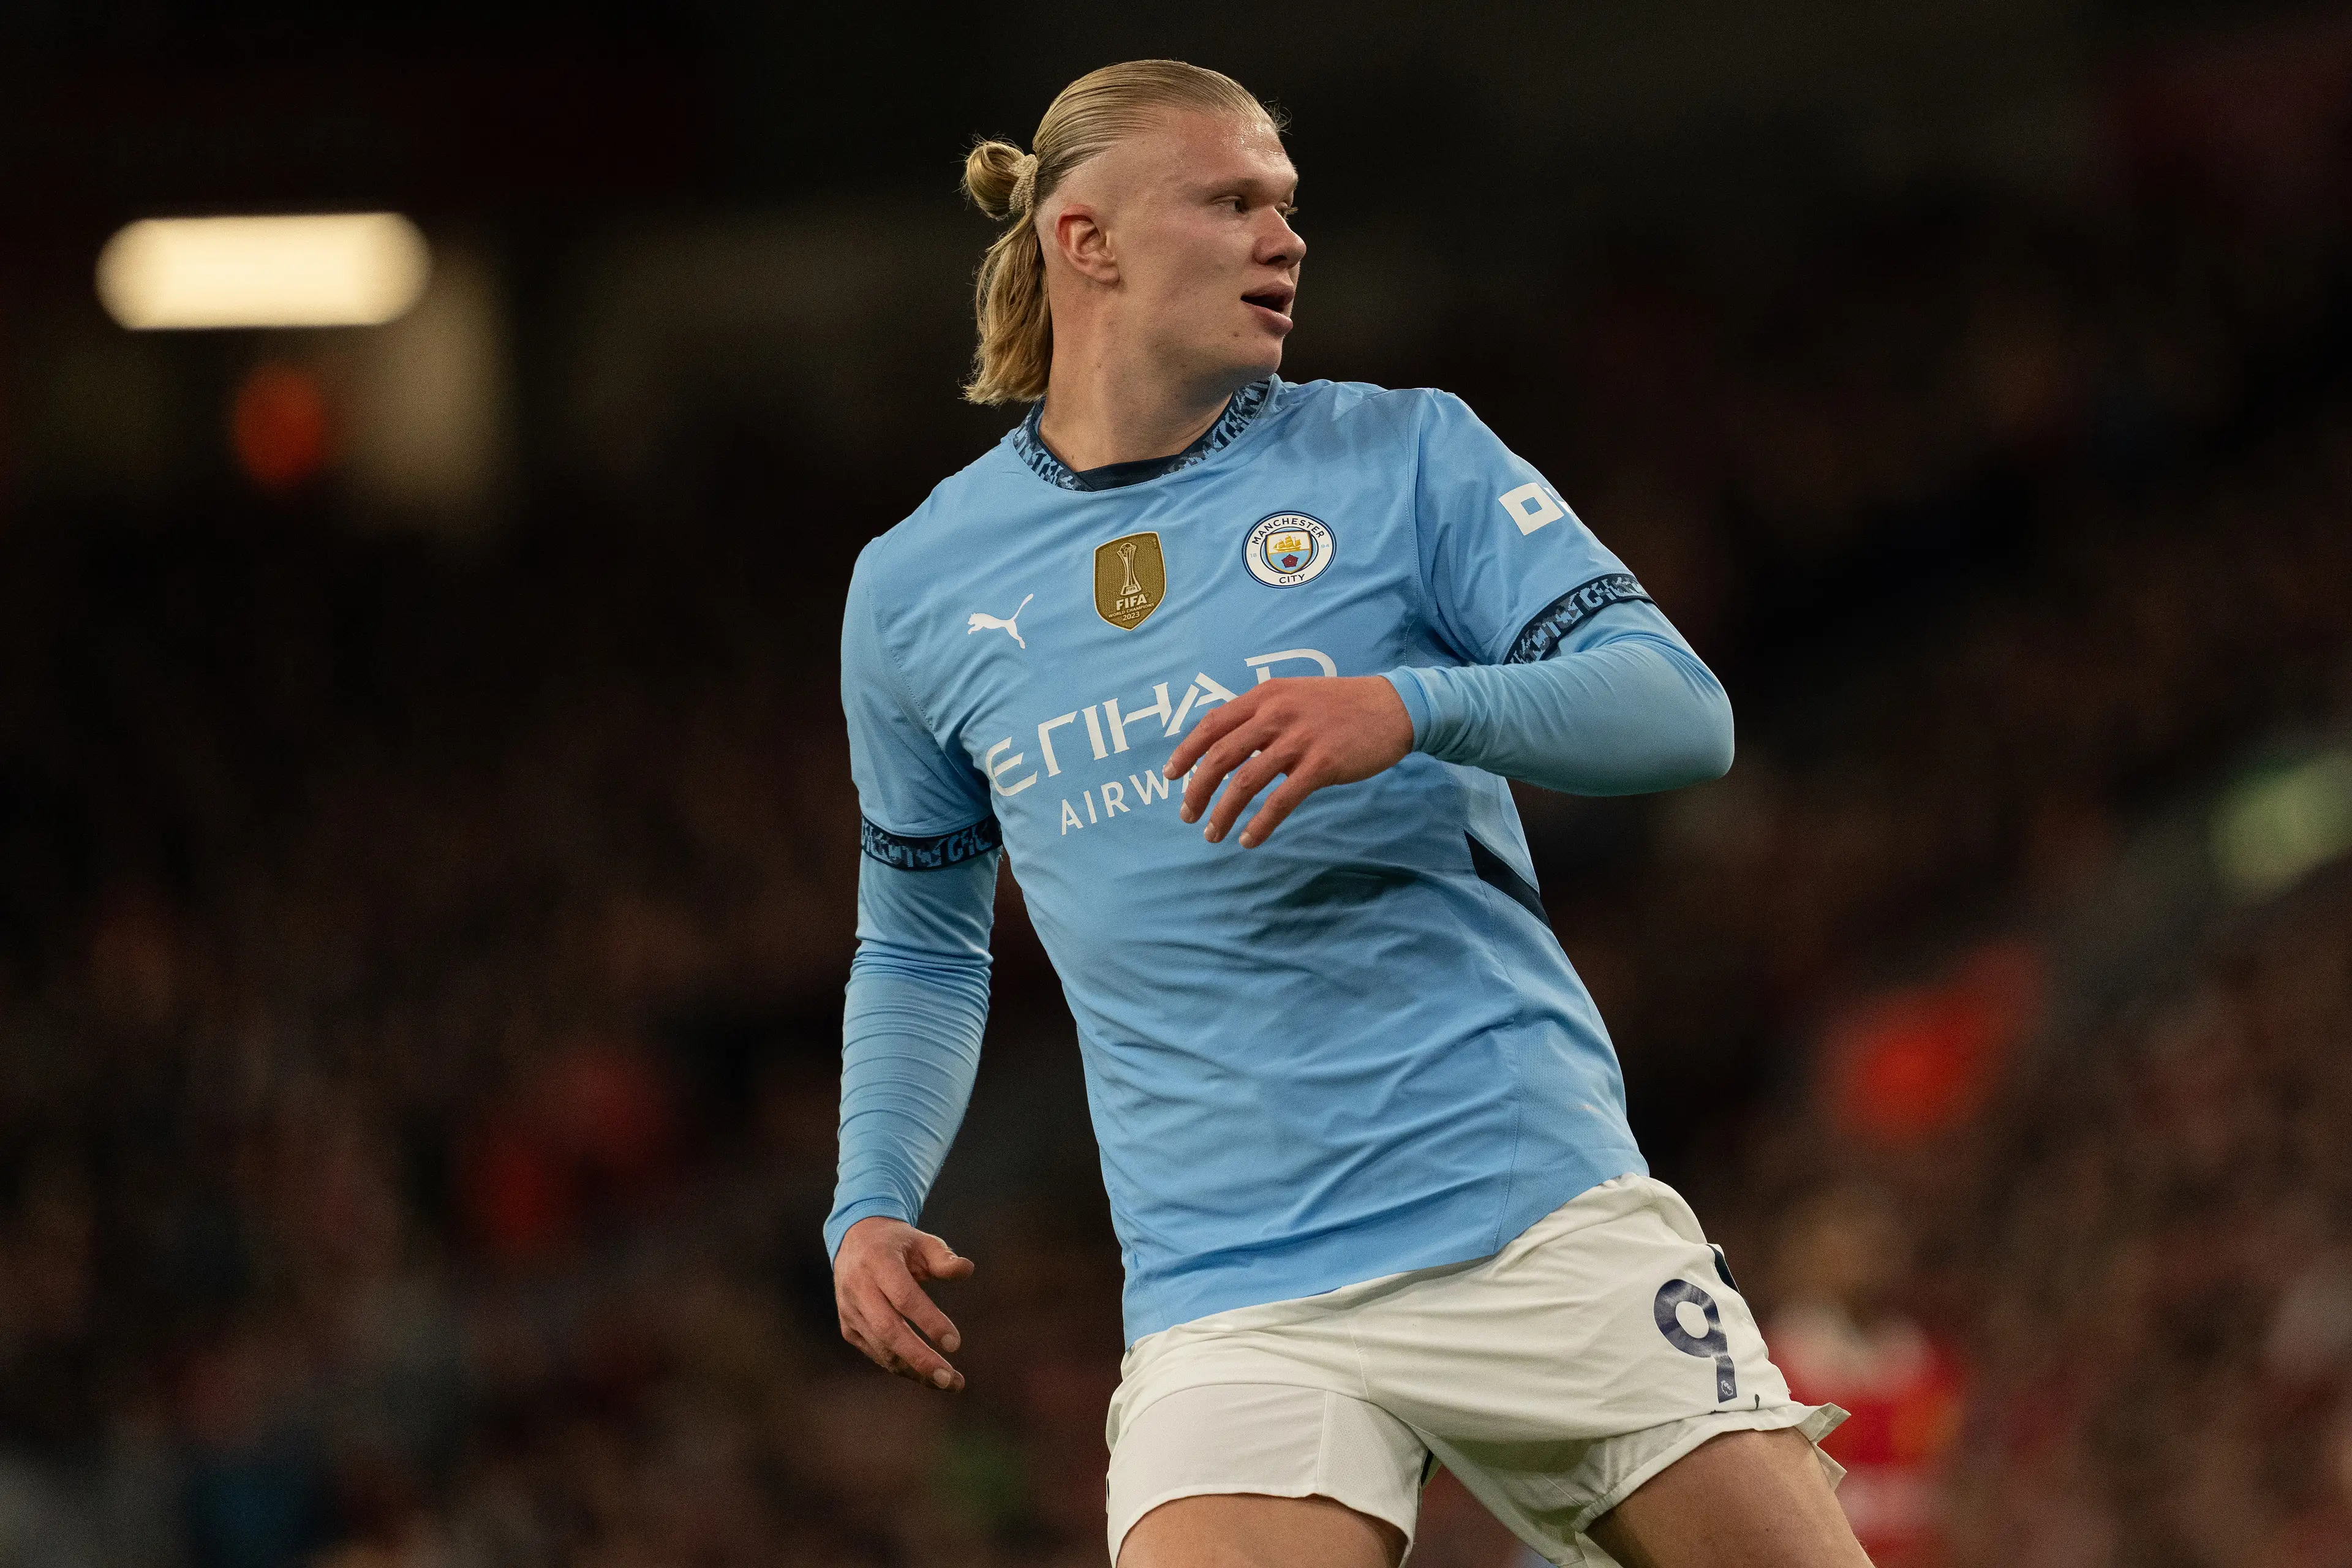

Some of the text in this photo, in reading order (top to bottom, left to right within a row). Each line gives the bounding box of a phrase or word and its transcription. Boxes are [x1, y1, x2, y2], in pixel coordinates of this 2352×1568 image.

[1251, 518, 1325, 545] MANCHESTER
[1279, 573, 1305, 584] CITY
[1116, 594, 1147, 611] FIFA
[1126, 603, 1155, 613] CHAMPIONS
[1122, 611, 1140, 622] 2023
[1061, 750, 1262, 835] AIRW
[1654, 1279, 1738, 1403] 9
